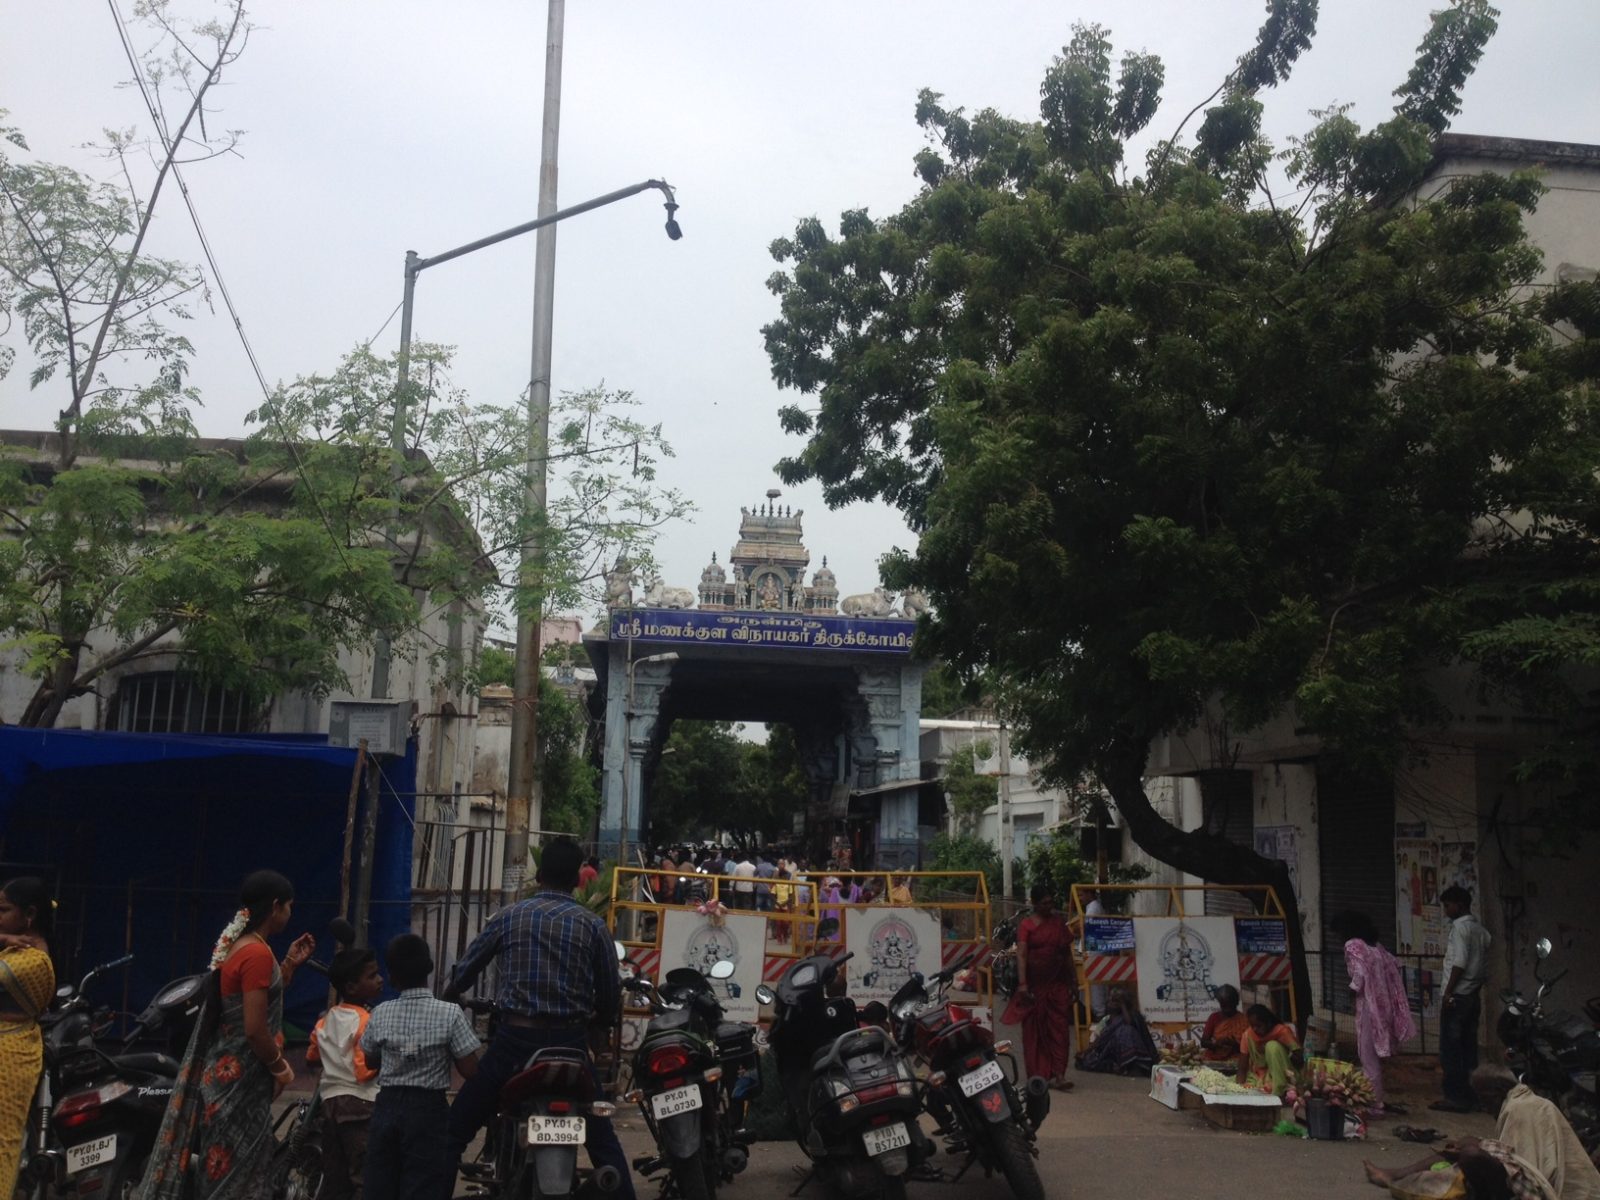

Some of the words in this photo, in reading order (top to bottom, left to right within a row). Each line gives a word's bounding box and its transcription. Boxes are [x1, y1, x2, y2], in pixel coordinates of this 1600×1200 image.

[644, 622, 728, 641] மணக்குள
[731, 625, 811, 644] விநாயகர்
[965, 1072, 1000, 1094] 7636
[664, 1090, 688, 1103] PY.01
[660, 1099, 697, 1116] BL.0730
[544, 1119, 571, 1128] PY.01
[537, 1132, 579, 1142] BD.3994
[875, 1135, 906, 1153] BS7211
[80, 1152, 101, 1167] 3399
